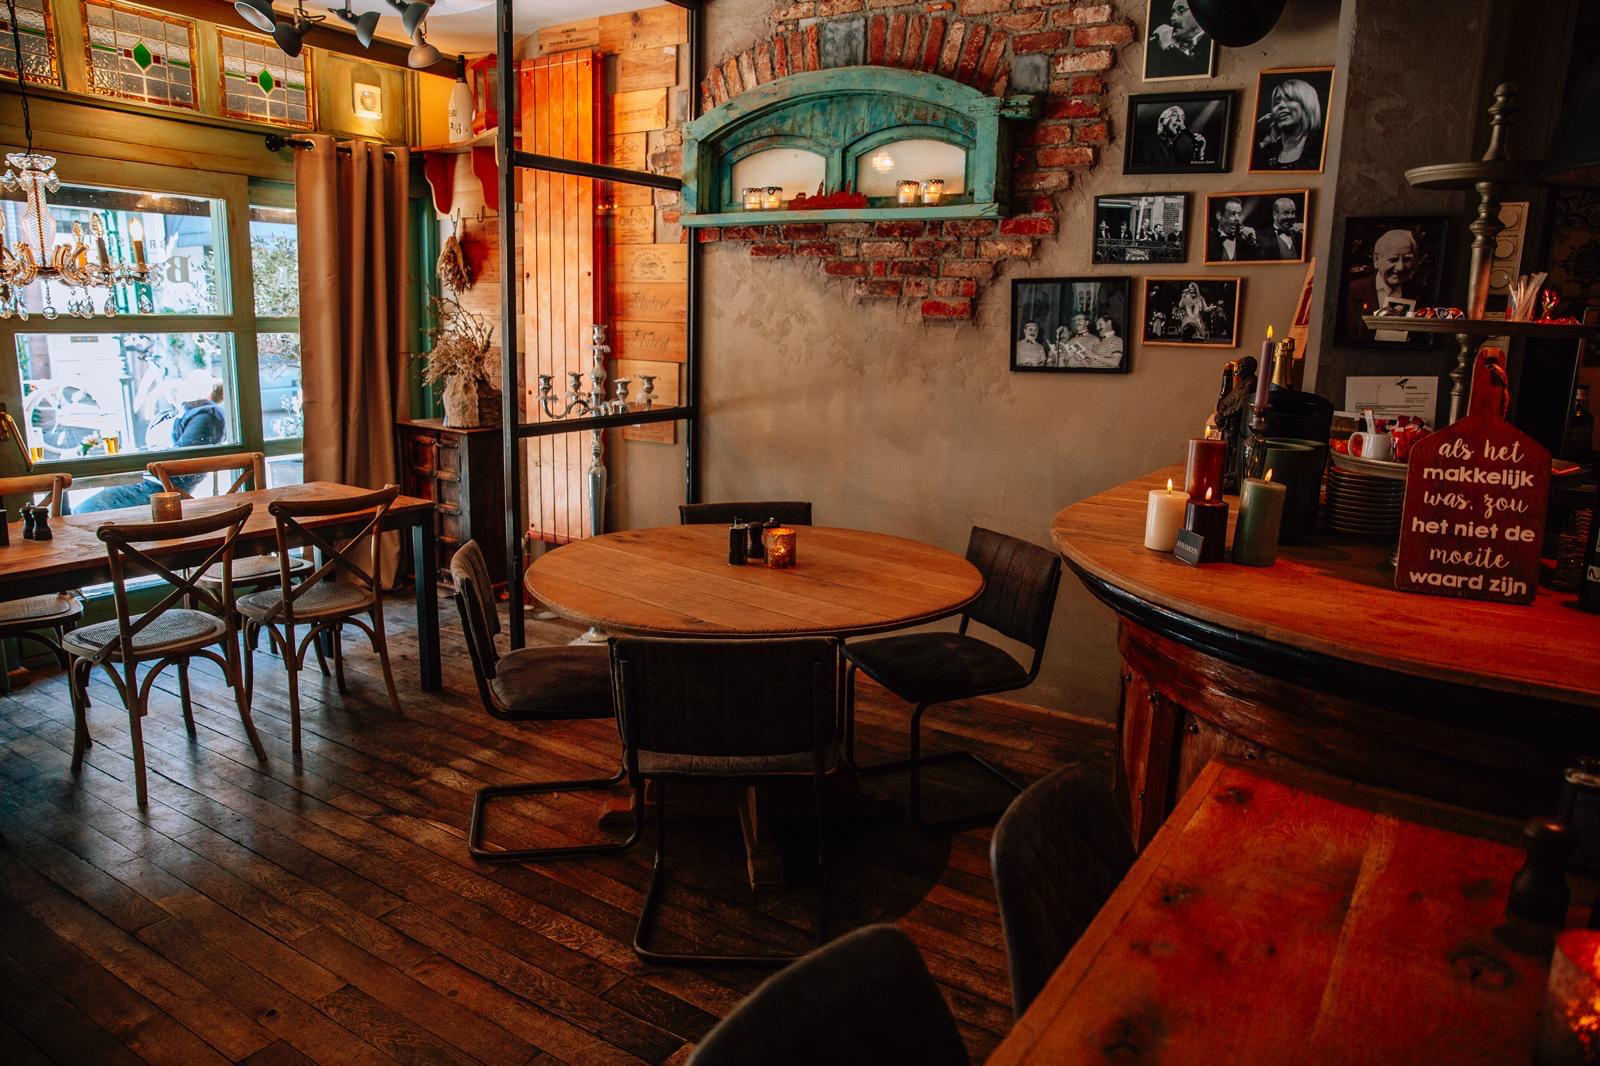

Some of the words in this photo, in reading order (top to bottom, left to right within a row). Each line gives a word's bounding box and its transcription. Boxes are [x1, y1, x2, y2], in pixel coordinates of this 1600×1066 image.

[1438, 437, 1475, 461] als
[1483, 438, 1525, 463] het
[1422, 466, 1535, 490] makkelijk
[1483, 493, 1529, 519] zou
[1411, 516, 1449, 535] het
[1454, 521, 1499, 540] niet
[1504, 525, 1536, 542] de
[1429, 546, 1510, 569] moeite
[1409, 570, 1484, 590] waard
[1488, 576, 1527, 597] zijn
